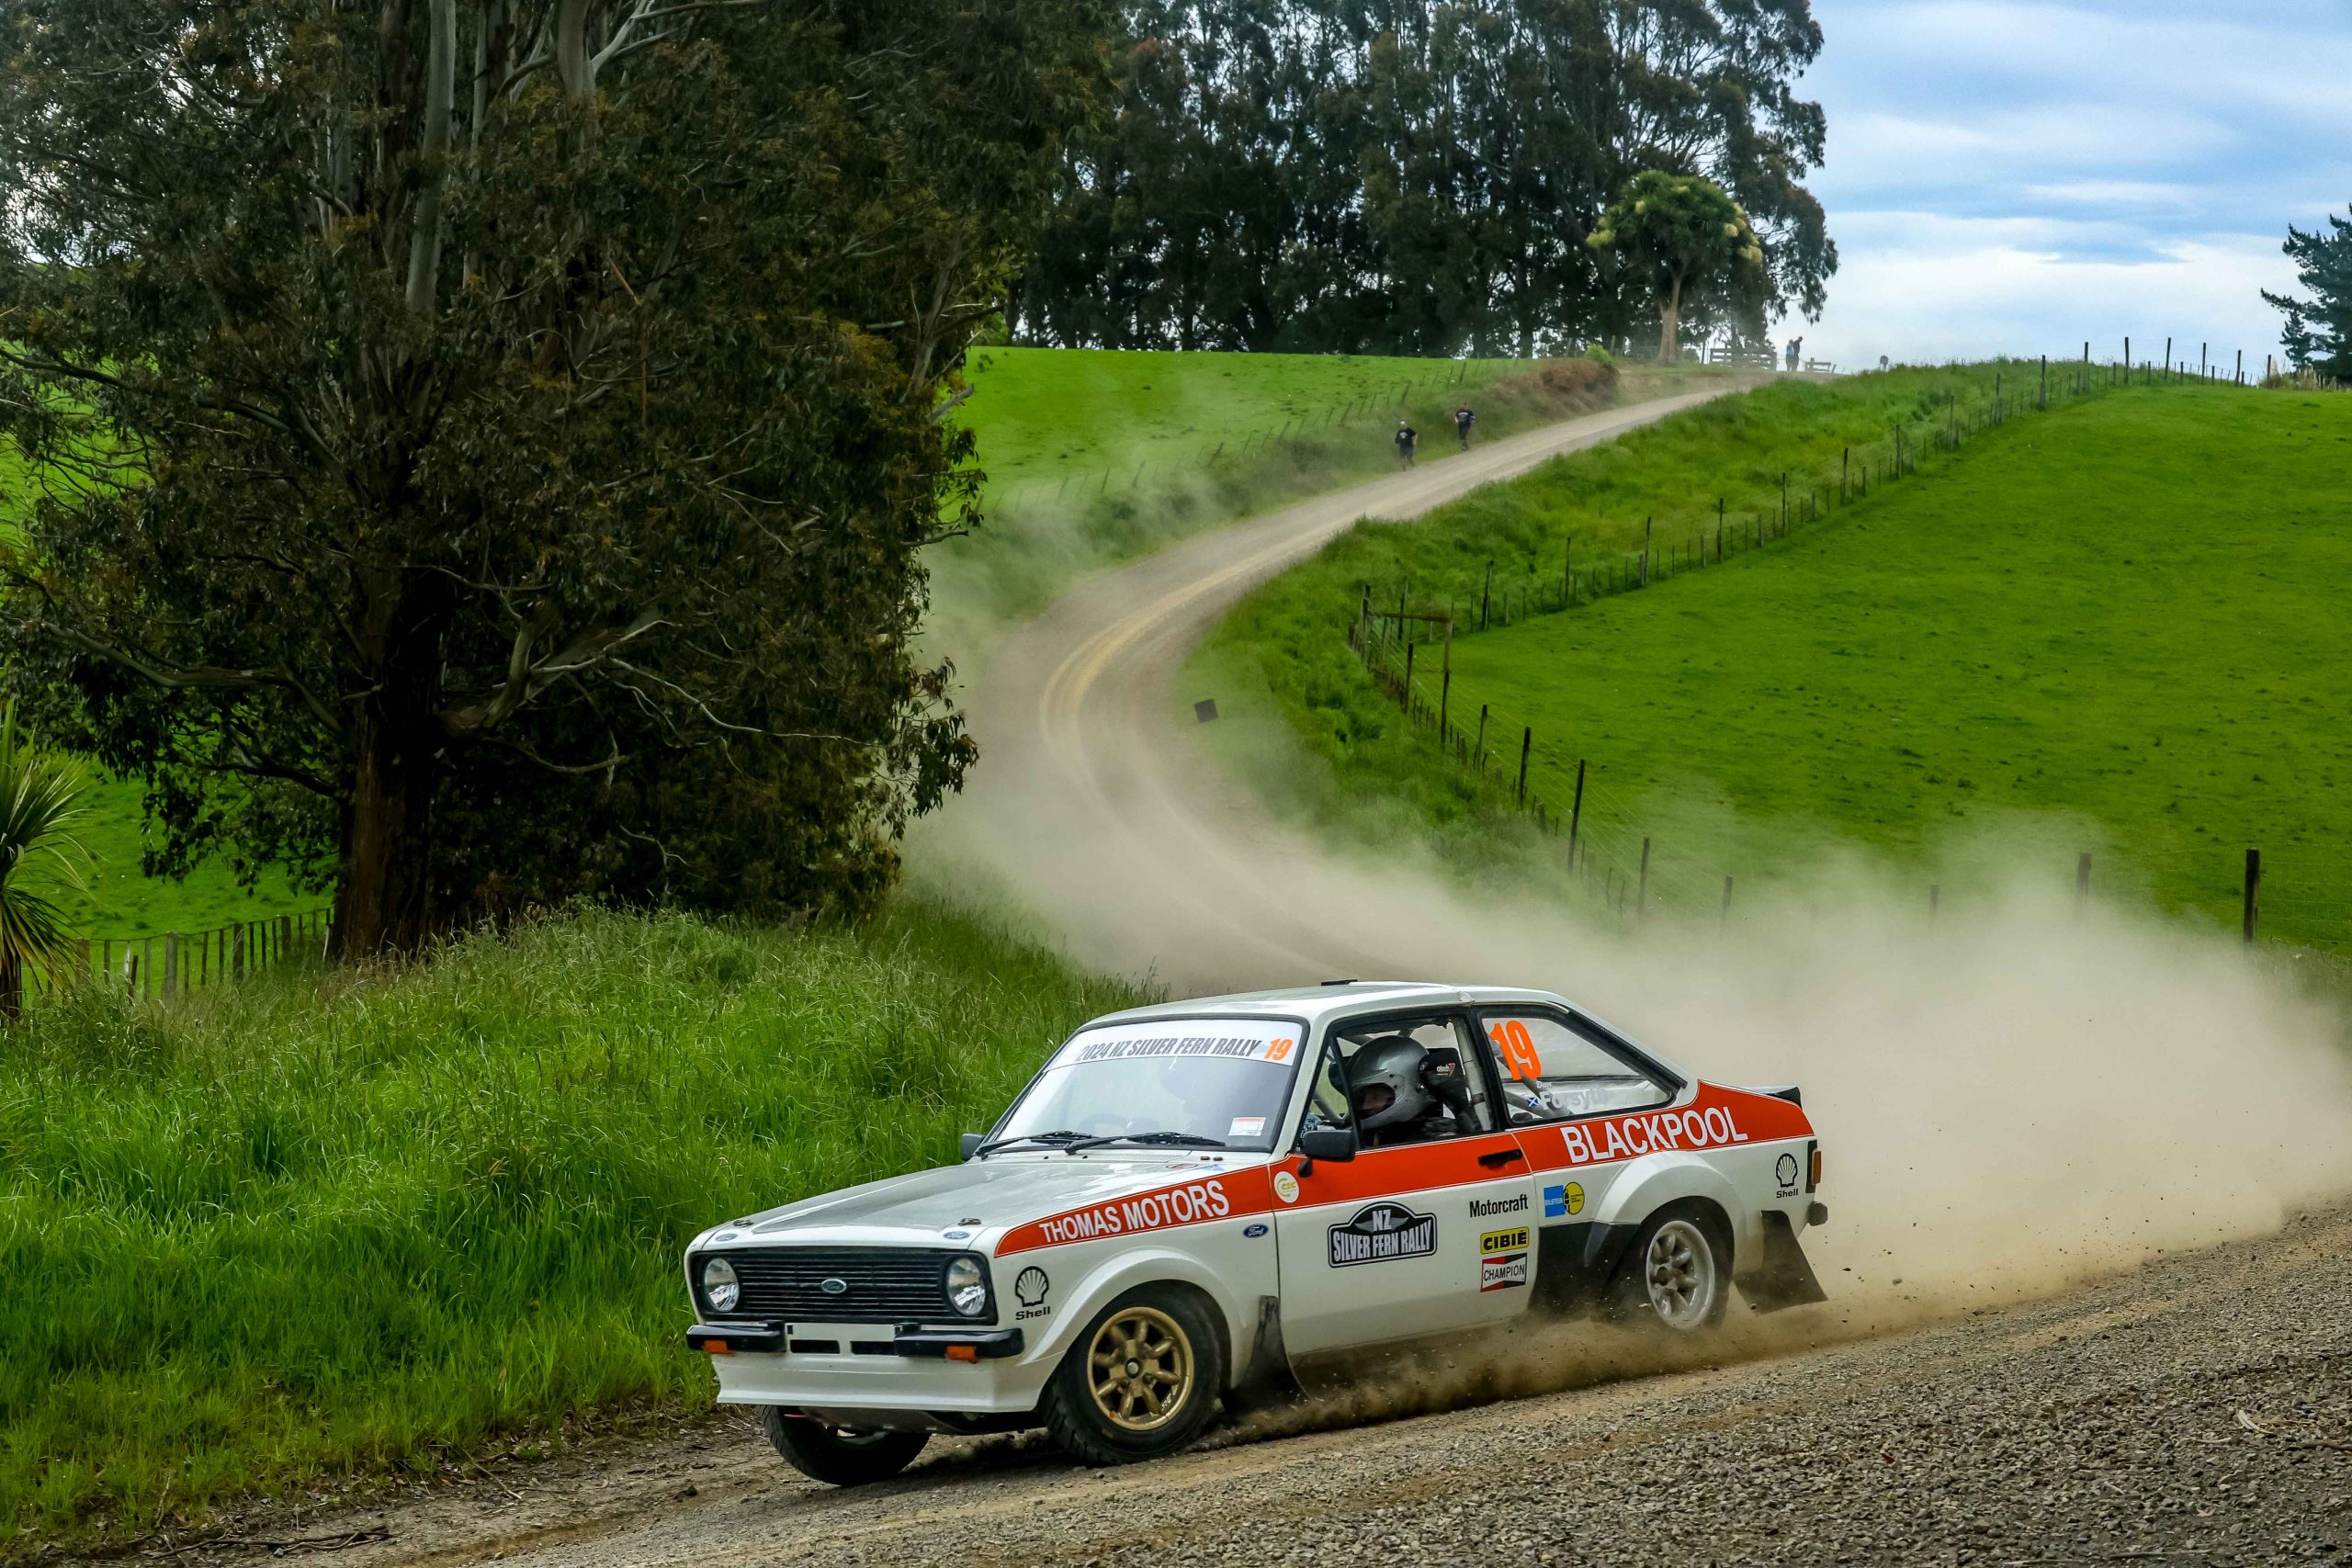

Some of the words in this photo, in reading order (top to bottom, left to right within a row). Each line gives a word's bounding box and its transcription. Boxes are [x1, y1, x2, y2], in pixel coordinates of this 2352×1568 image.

[1075, 1043, 1114, 1062] 2024
[1108, 1040, 1133, 1057] NZ
[1127, 1038, 1179, 1055] SILVER
[1173, 1037, 1216, 1055] FERN
[1211, 1038, 1262, 1056] RALLY
[1264, 1038, 1293, 1061] 19
[1489, 1020, 1542, 1080] 19
[1560, 1107, 1749, 1163] BLACKPOOL
[1776, 1188, 1798, 1199] Shell
[1039, 1206, 1122, 1243] THOMAS
[1121, 1180, 1230, 1231] MOTORS
[1470, 1194, 1528, 1218] Motorcraft
[1372, 1209, 1393, 1232] NZ
[1333, 1231, 1371, 1261] SILVER
[1373, 1232, 1398, 1257] FERN
[1400, 1219, 1431, 1253] RALLY
[1484, 1264, 1525, 1281] CHAMPION
[1015, 1306, 1050, 1320] Shell
